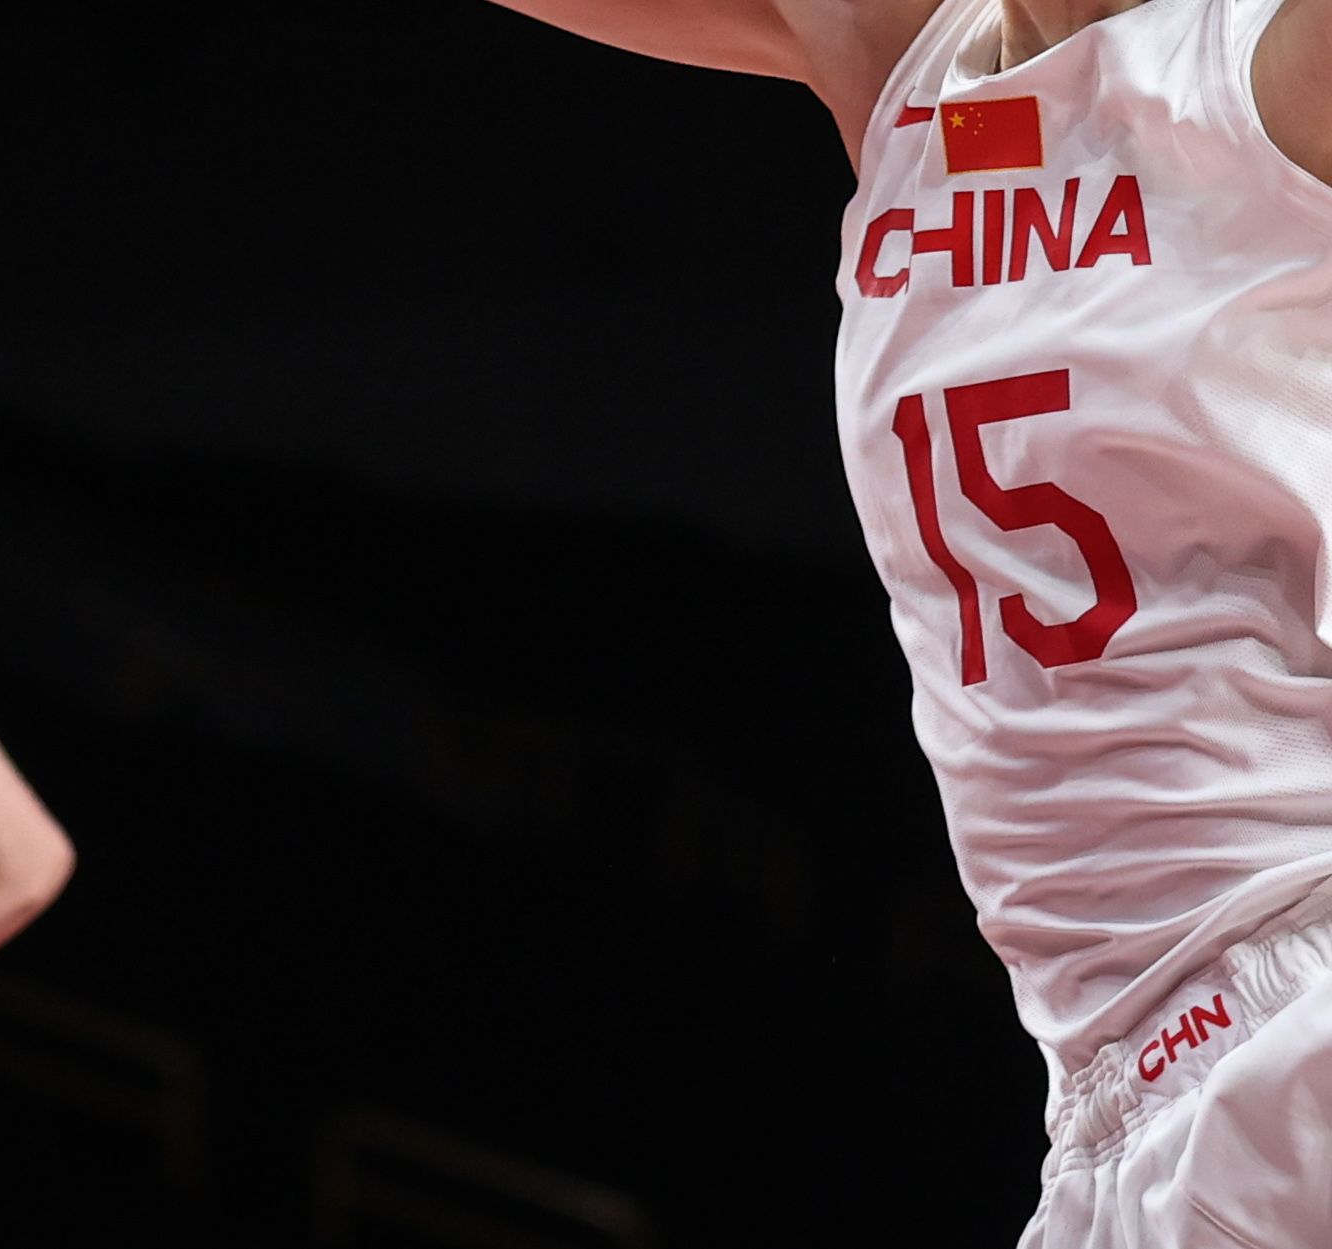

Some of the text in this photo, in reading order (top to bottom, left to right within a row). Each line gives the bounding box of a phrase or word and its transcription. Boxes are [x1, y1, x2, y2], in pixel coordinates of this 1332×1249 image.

[855, 175, 1151, 298] CHINA
[891, 368, 1138, 687] 15
[1138, 993, 1232, 1082] CHN
